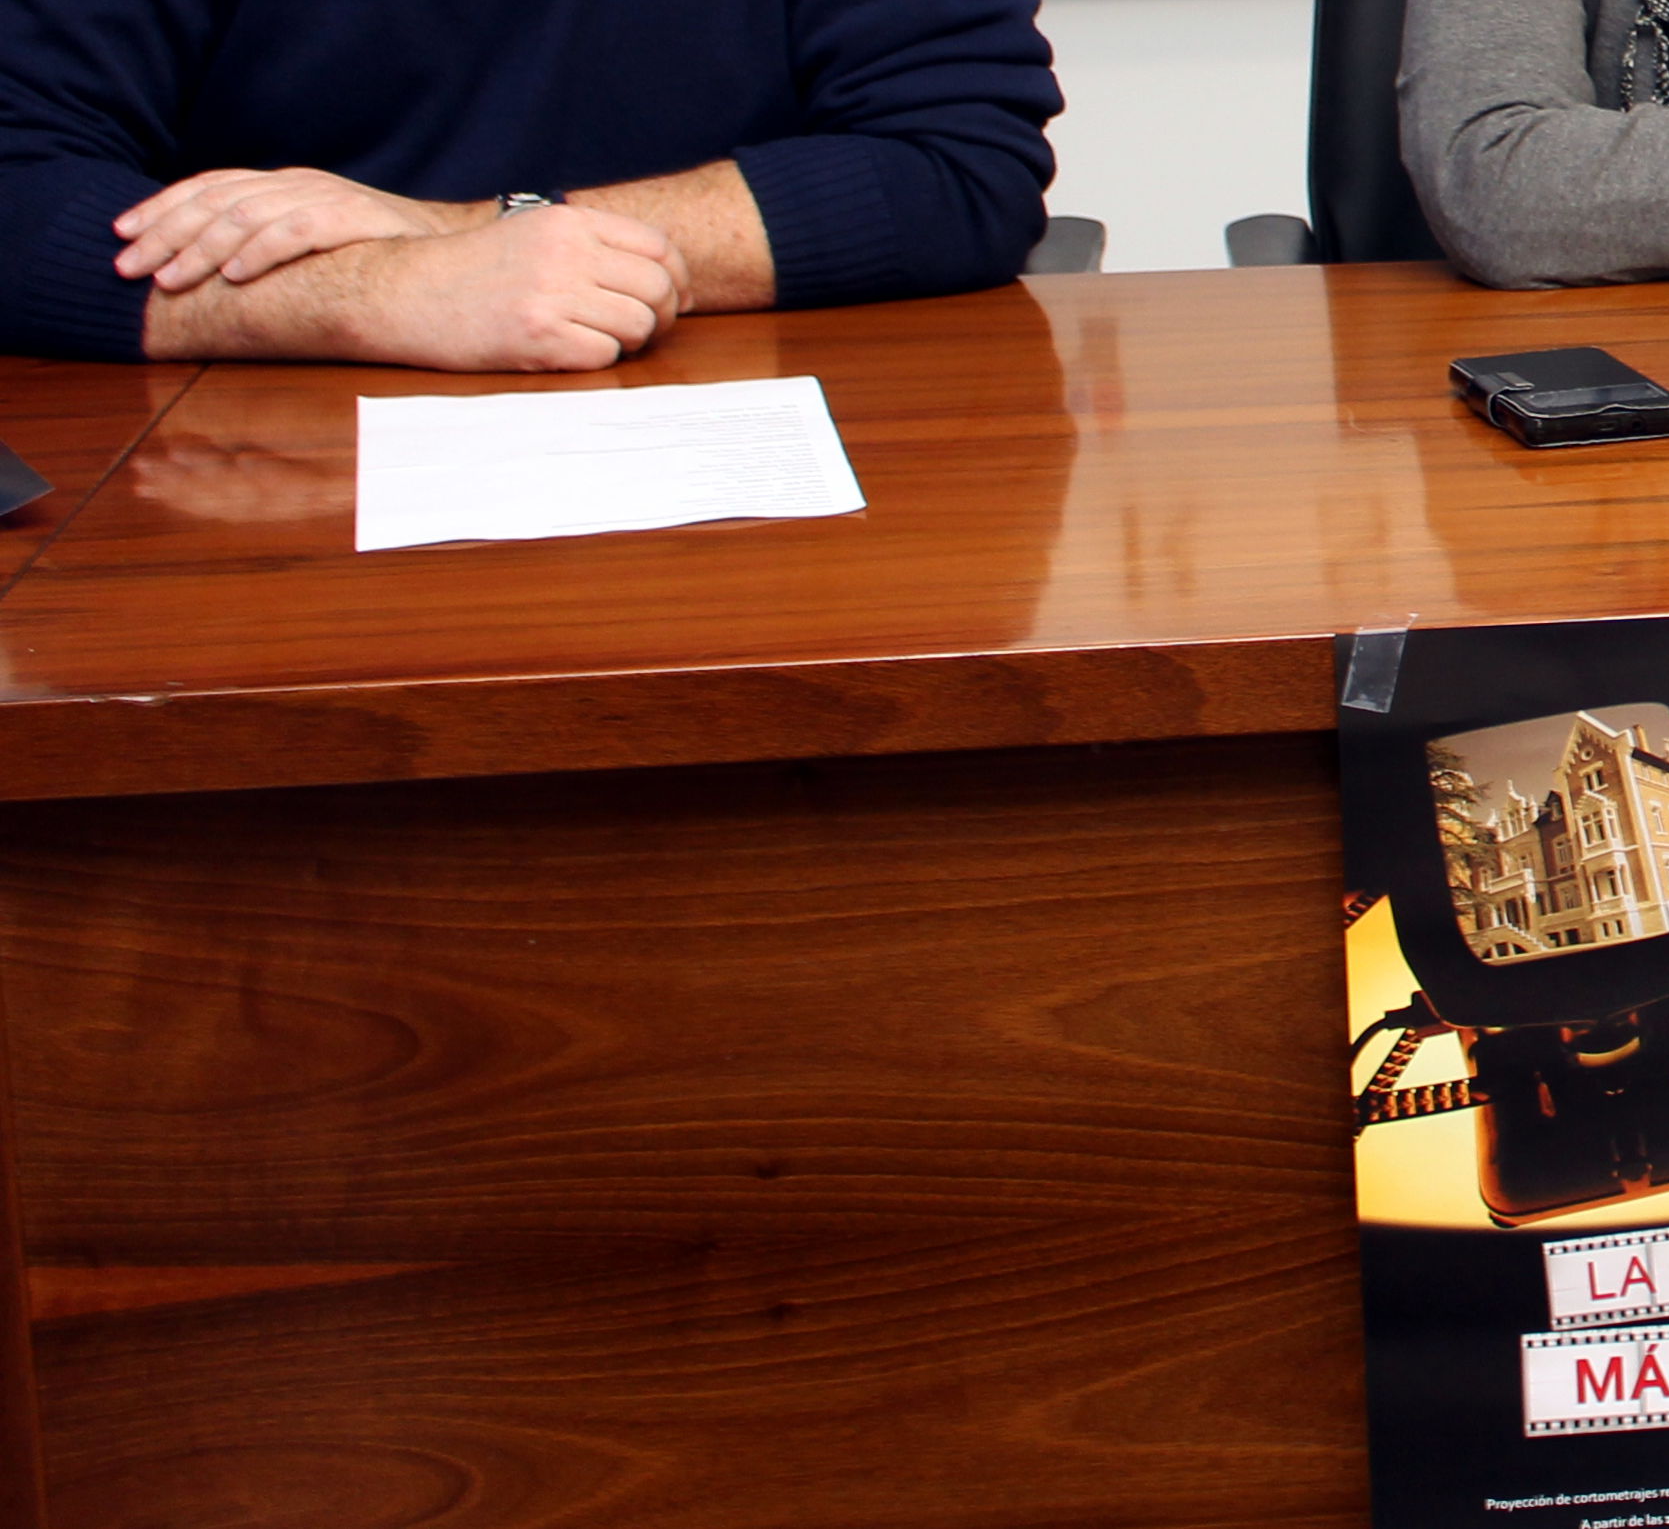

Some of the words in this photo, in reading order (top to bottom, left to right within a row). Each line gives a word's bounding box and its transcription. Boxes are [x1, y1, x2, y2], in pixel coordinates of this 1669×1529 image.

[1586, 1256, 1657, 1302] LA
[1485, 1494, 1554, 1512] Proyección
[1555, 1493, 1572, 1506] de
[1573, 1487, 1658, 1504] cortometrajes
[1580, 1519, 1592, 1529] A
[1593, 1517, 1629, 1529] partir
[1629, 1516, 1644, 1528] de
[1646, 1514, 1663, 1526] las
